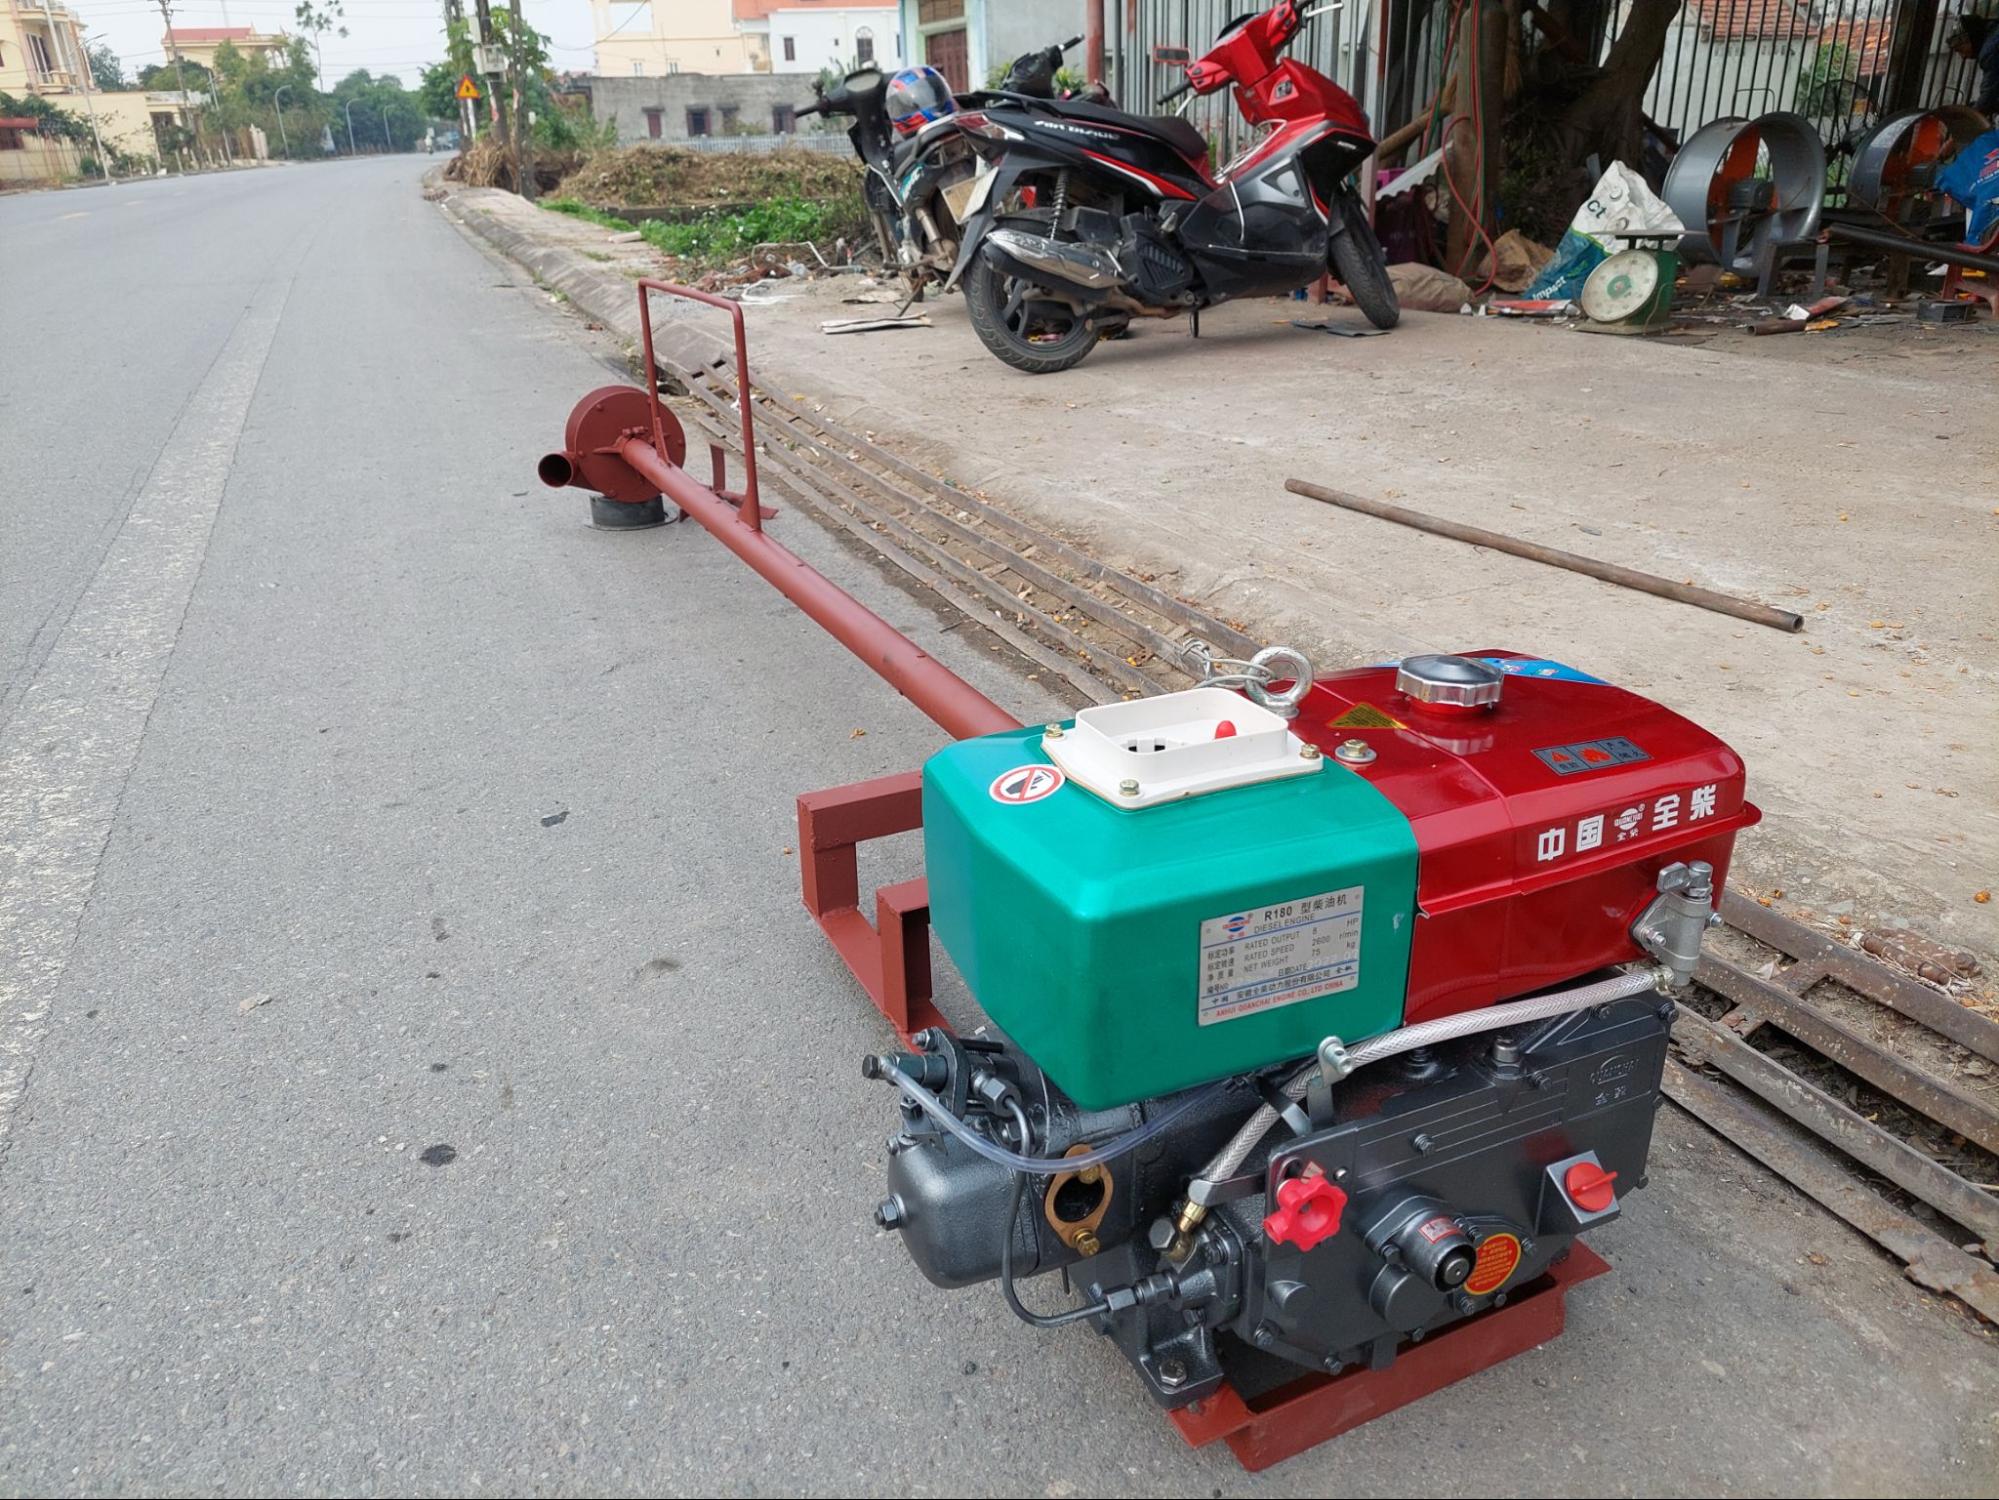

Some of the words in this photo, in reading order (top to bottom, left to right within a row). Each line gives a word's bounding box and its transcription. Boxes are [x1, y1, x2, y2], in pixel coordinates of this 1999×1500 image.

[1537, 814, 1605, 862] 中国
[1651, 783, 1717, 832] 全柴
[1265, 906, 1292, 921] R180
[1254, 921, 1281, 933] DIESEL
[1285, 913, 1315, 926] ENGINE
[1244, 939, 1268, 950] RATED
[1244, 950, 1267, 962] RATED
[1271, 944, 1294, 955] SPEED
